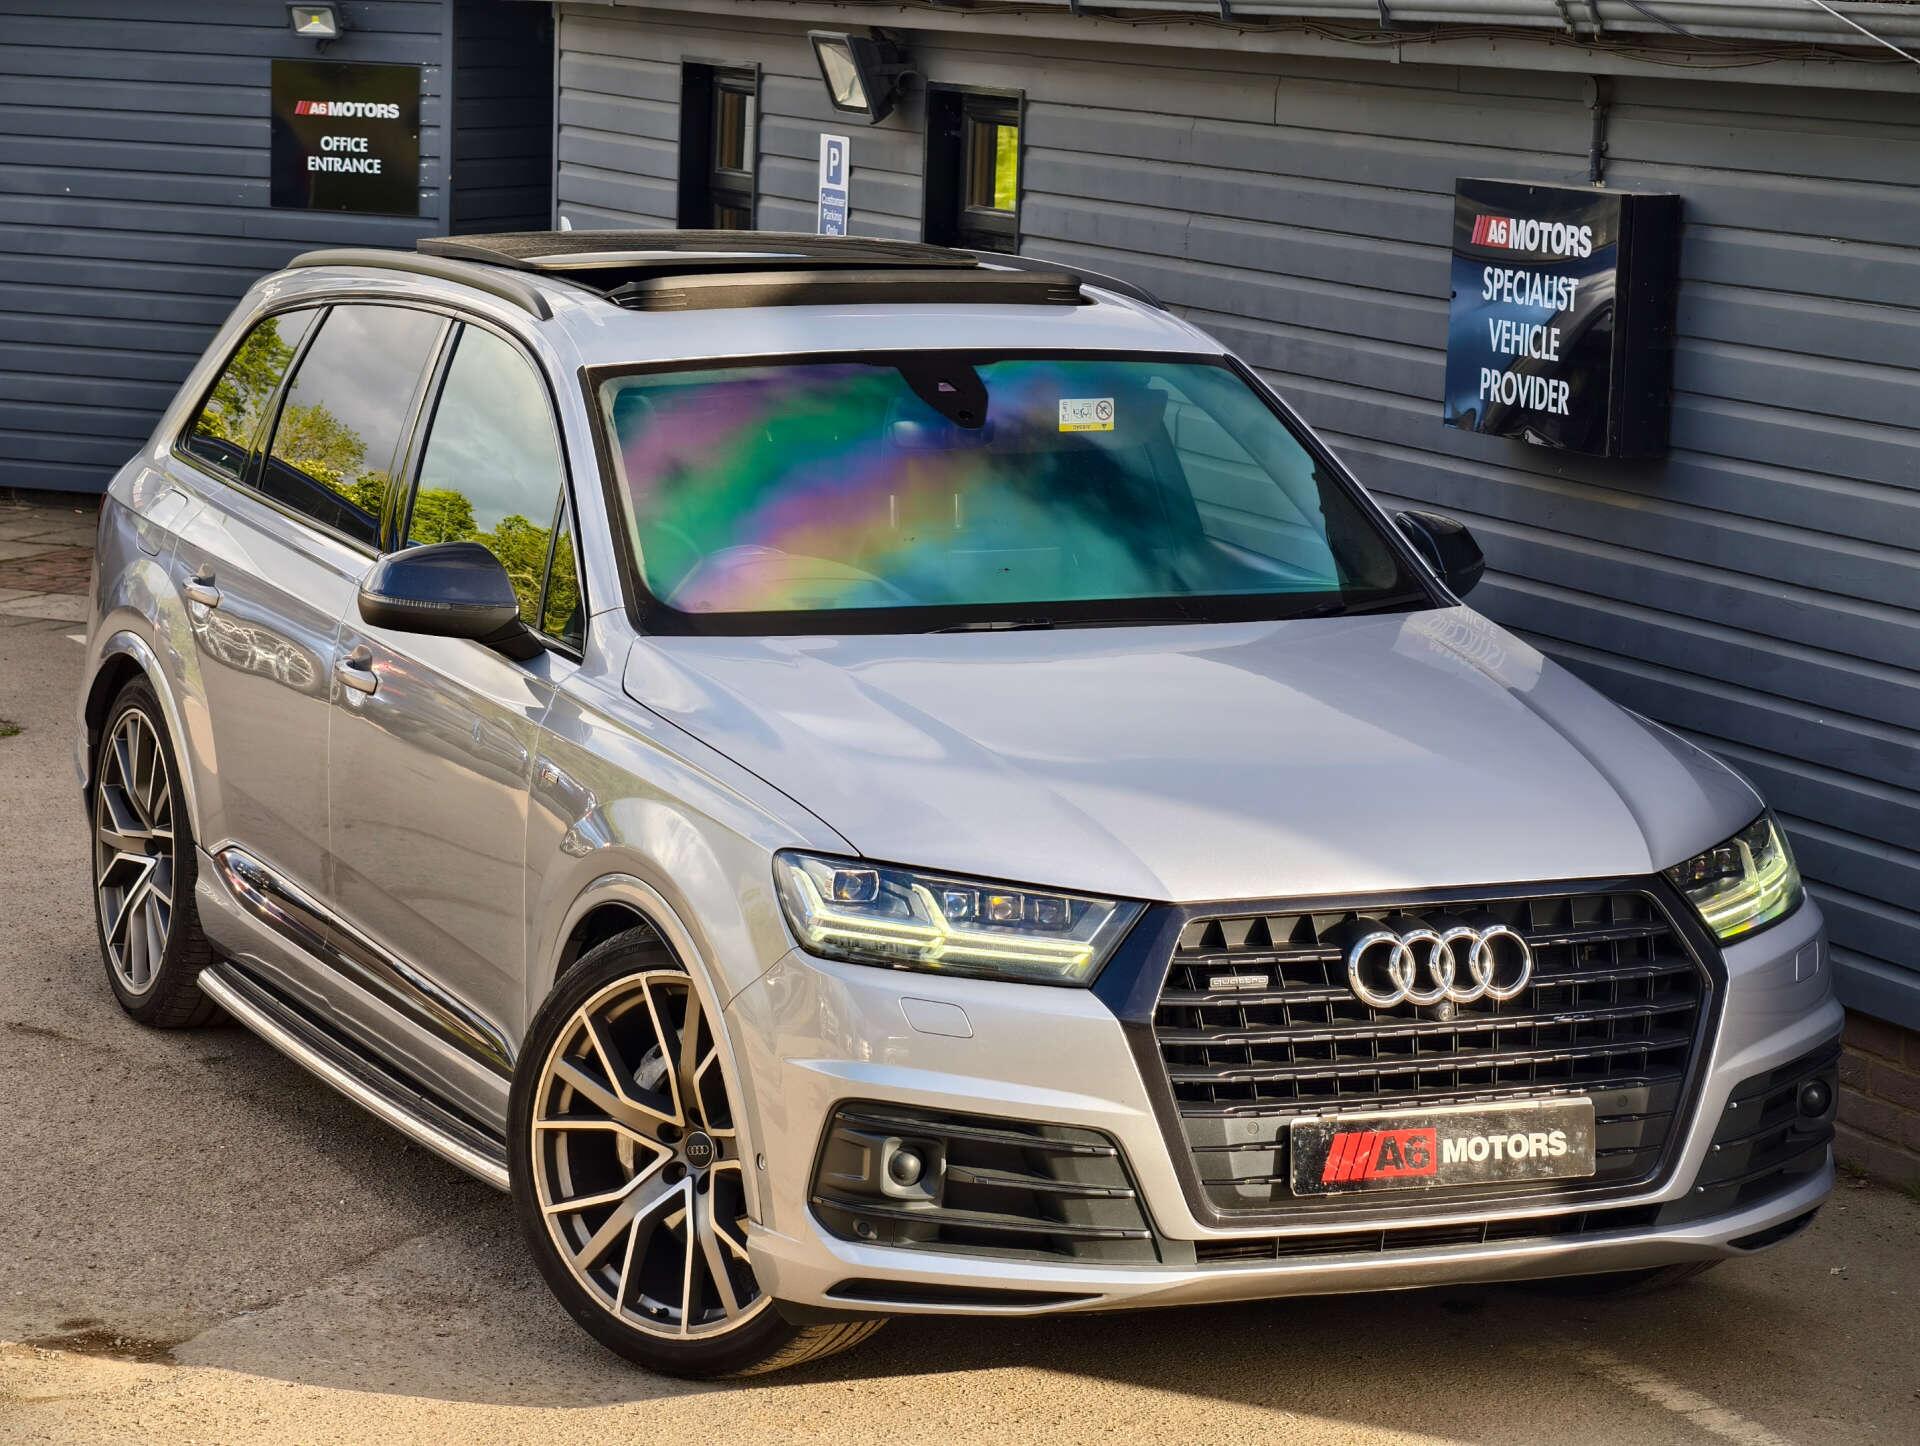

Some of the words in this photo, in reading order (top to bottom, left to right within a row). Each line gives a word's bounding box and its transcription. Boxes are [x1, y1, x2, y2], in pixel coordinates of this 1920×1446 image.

[309, 102, 328, 115] A6
[328, 101, 400, 119] MOTORS
[320, 136, 369, 152] OFFICE
[307, 156, 382, 174] ENTRANCE
[829, 147, 839, 177] P
[823, 208, 843, 225] Parking
[1487, 219, 1507, 245] A6
[1508, 218, 1593, 258] MOTORS
[1482, 266, 1580, 312] SPECIALIST
[1488, 318, 1561, 362] VEHICLE
[1479, 368, 1570, 415] PROVIDER
[1374, 1135, 1431, 1172] A6
[1442, 1131, 1567, 1163] MOTORS
